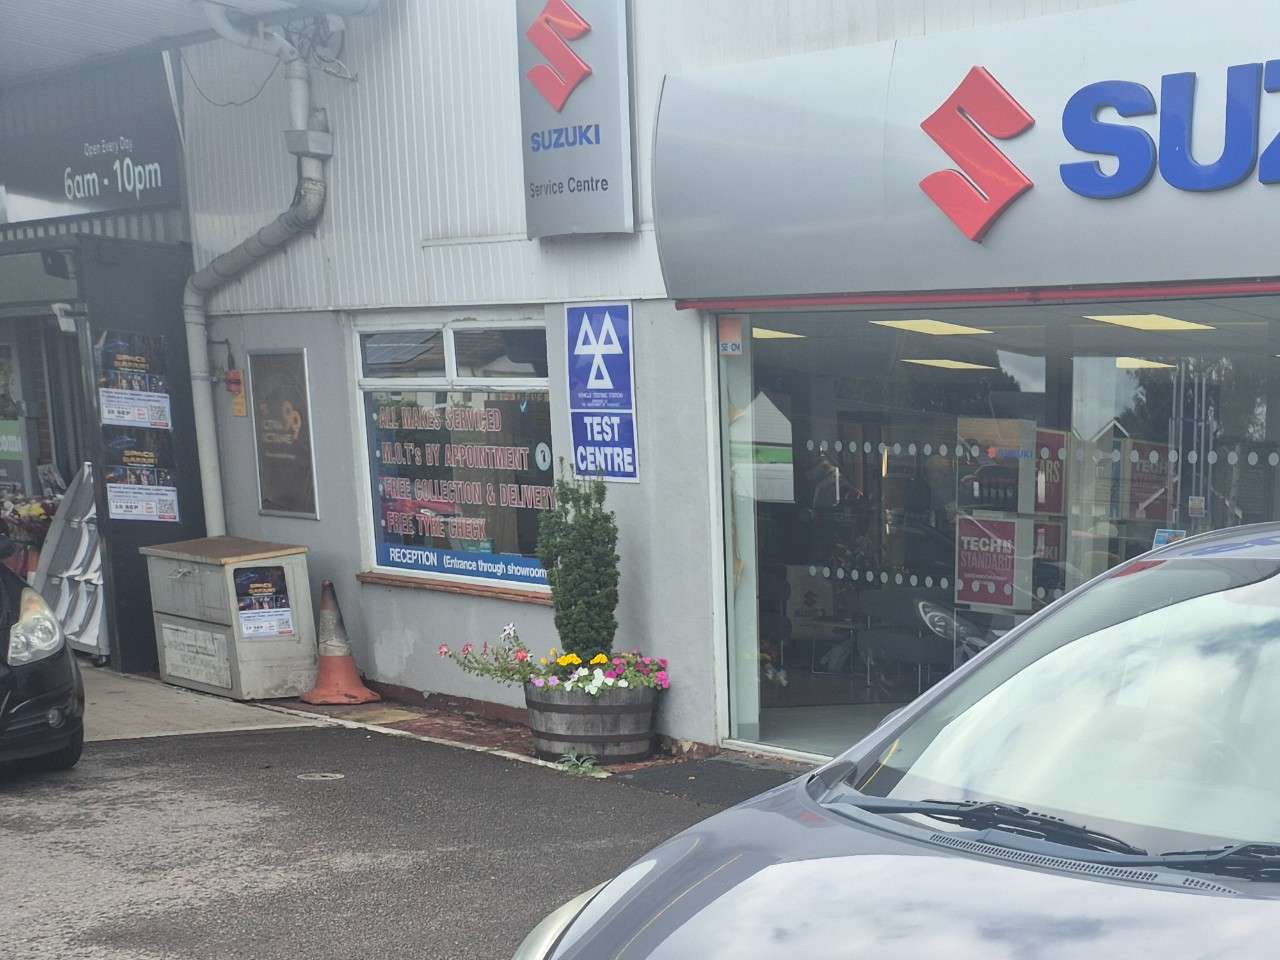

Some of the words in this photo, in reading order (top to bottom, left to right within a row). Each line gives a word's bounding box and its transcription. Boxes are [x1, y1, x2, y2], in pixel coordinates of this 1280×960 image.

[530, 124, 600, 152] SUZUKI
[64, 167, 99, 200] 6am
[113, 157, 162, 200] 10pm
[530, 182, 564, 198] Service
[567, 176, 608, 193] Centre
[379, 407, 400, 430] ALL
[401, 407, 441, 431] MAKES
[446, 408, 501, 432] SERVICED
[584, 416, 620, 442] TEST
[382, 441, 422, 466] M.O.T's
[425, 443, 441, 466] BY
[445, 443, 529, 471] APPOINTMENT
[577, 446, 634, 473] CENTRE
[384, 477, 411, 500] FREE
[415, 479, 482, 505] COLLECTION
[487, 483, 496, 506] &
[500, 485, 557, 510] DELIVERY
[386, 511, 415, 535] FREE
[416, 514, 445, 537] TYRE
[450, 517, 486, 541] CHECK
[390, 548, 437, 566] RECEPTION
[443, 555, 477, 571] (Entrance
[478, 560, 506, 576] through
[960, 551, 1012, 570] STANDARD
